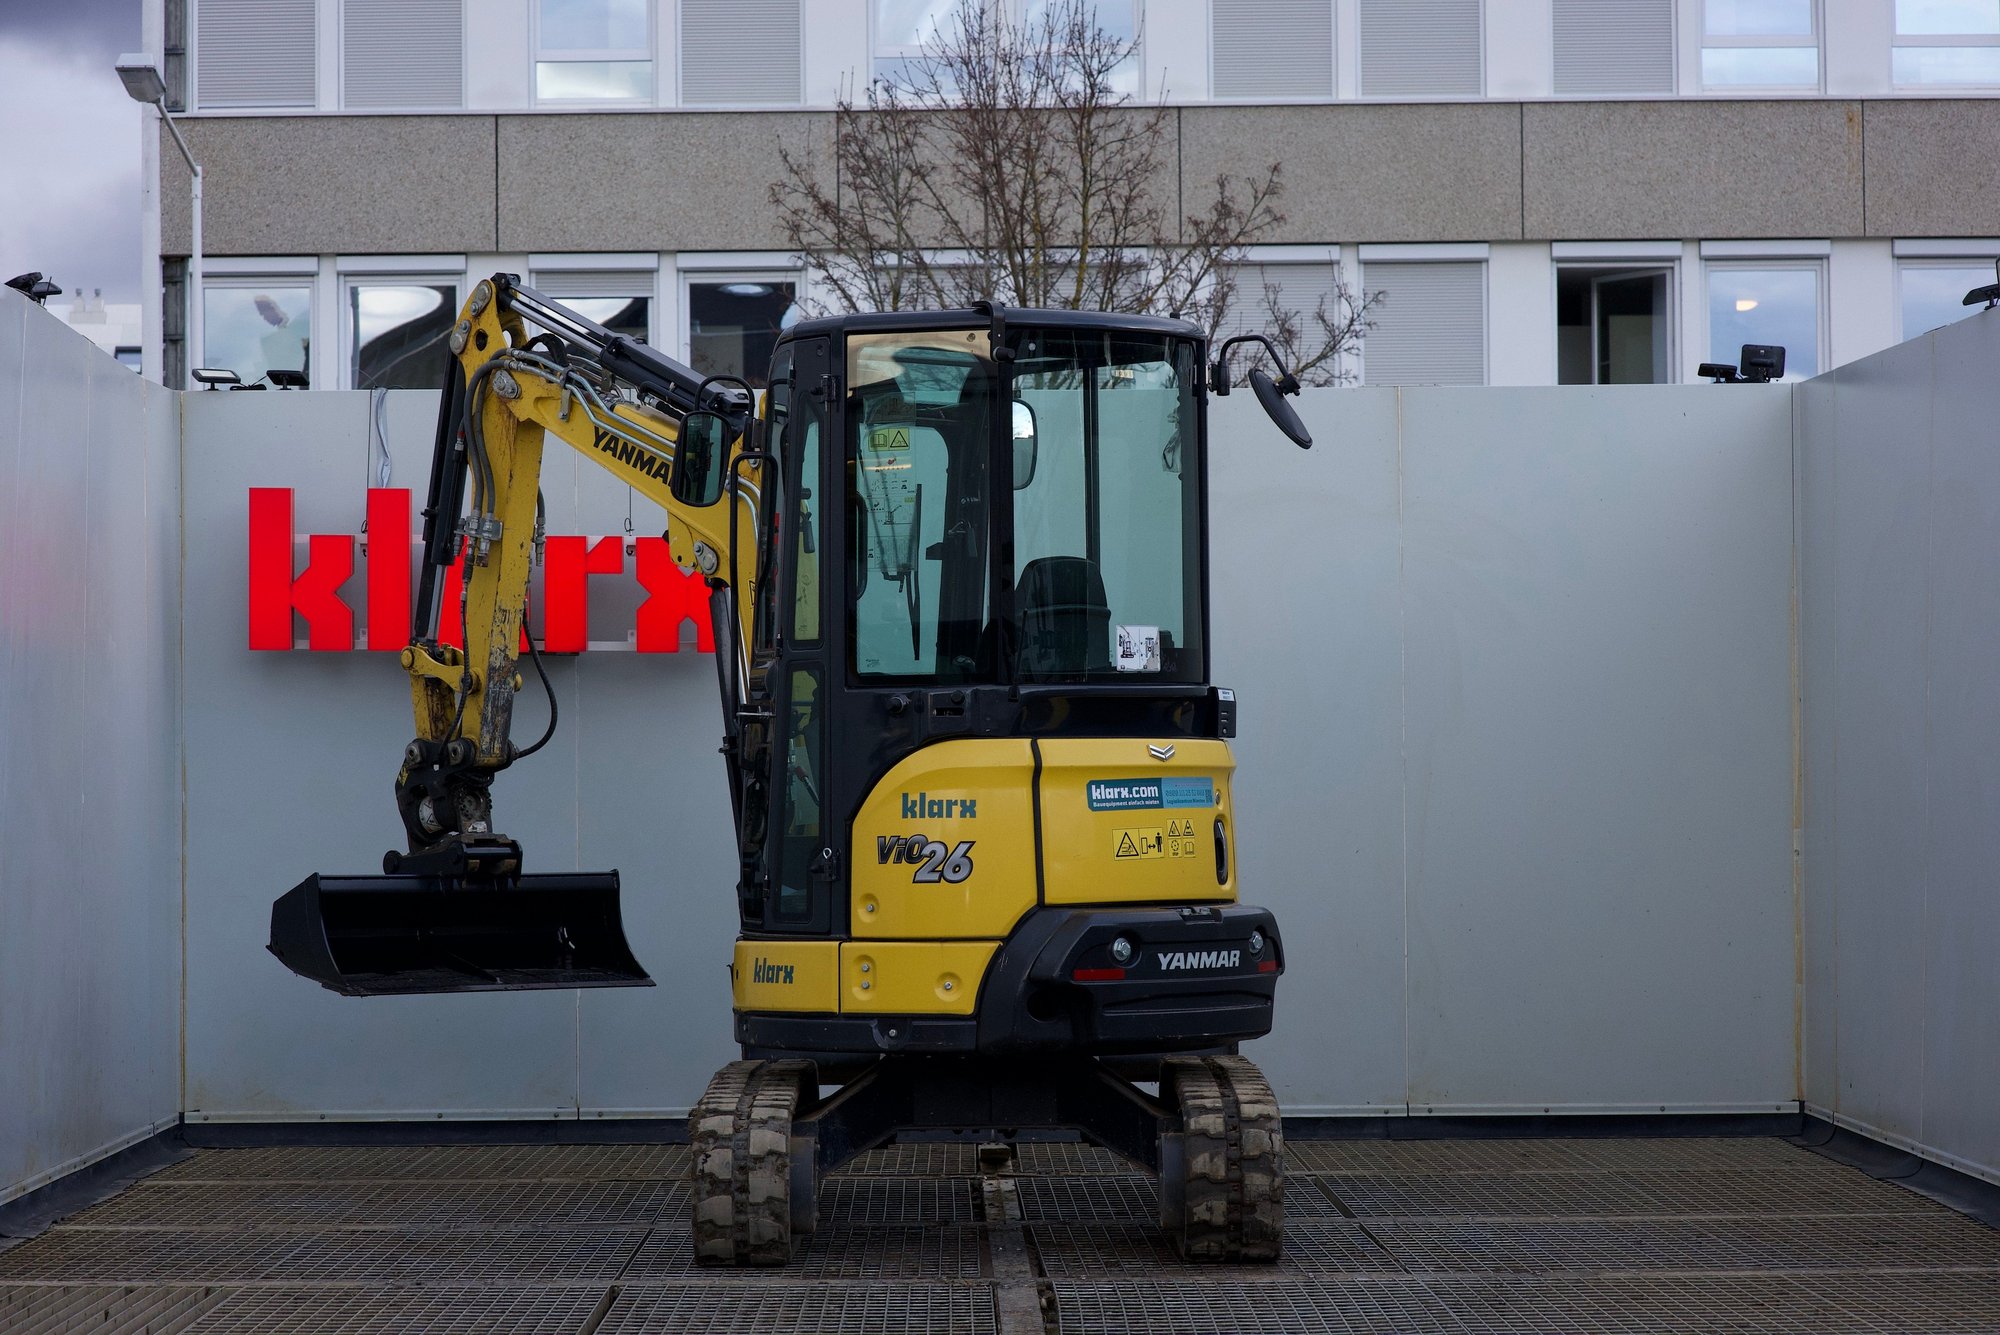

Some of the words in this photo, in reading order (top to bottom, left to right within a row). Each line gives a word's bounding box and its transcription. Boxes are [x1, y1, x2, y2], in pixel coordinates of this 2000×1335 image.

[593, 425, 672, 487] YANMA
[902, 792, 977, 819] klarx
[1091, 784, 1159, 800] klarx.com
[753, 957, 795, 984] klarx
[1157, 950, 1241, 970] YANMAR
